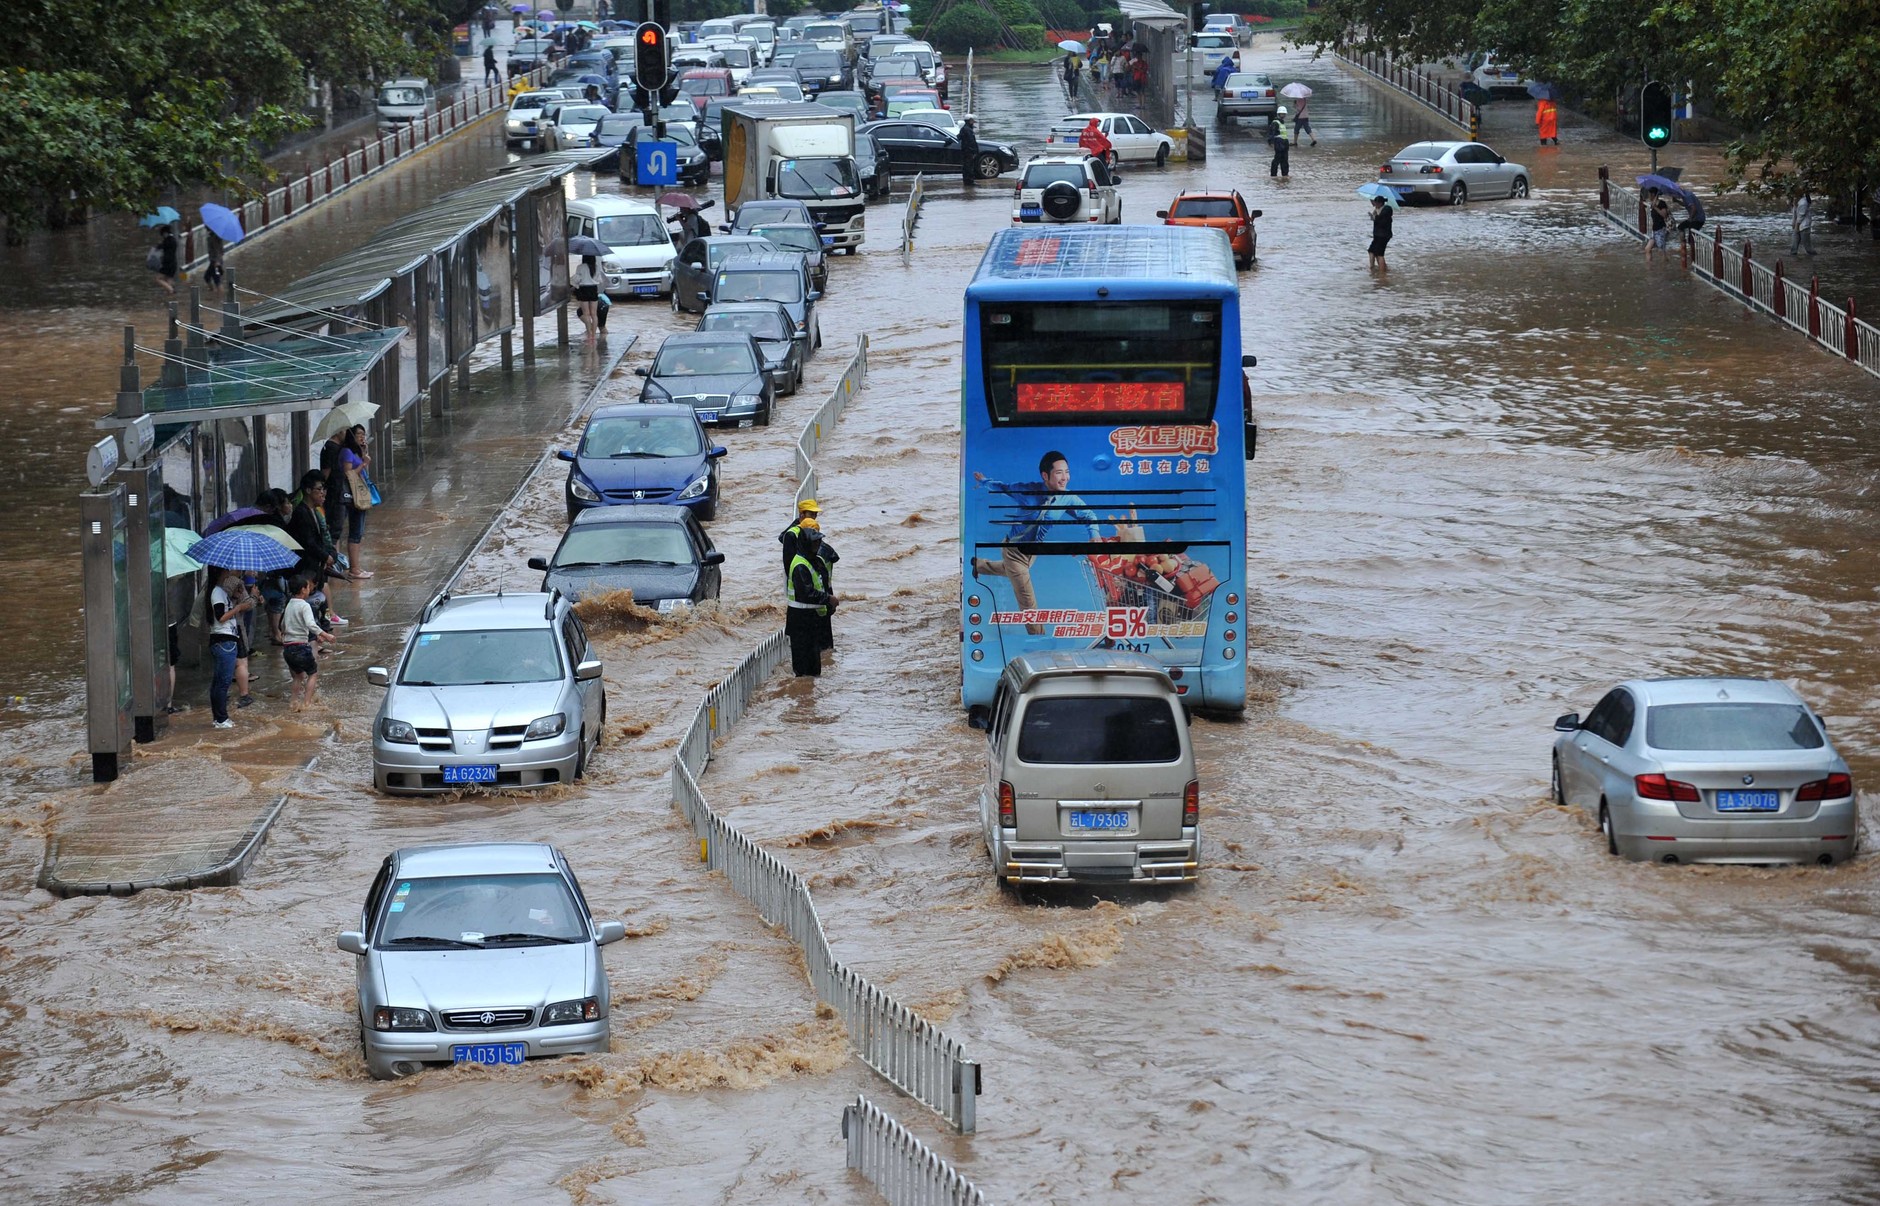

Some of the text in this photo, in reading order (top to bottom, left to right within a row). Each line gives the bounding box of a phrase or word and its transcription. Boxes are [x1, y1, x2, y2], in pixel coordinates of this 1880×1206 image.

[1117, 426, 1213, 451] 最红星期五
[1120, 460, 1210, 475] 优惠在身边
[1108, 609, 1146, 637] 5%
